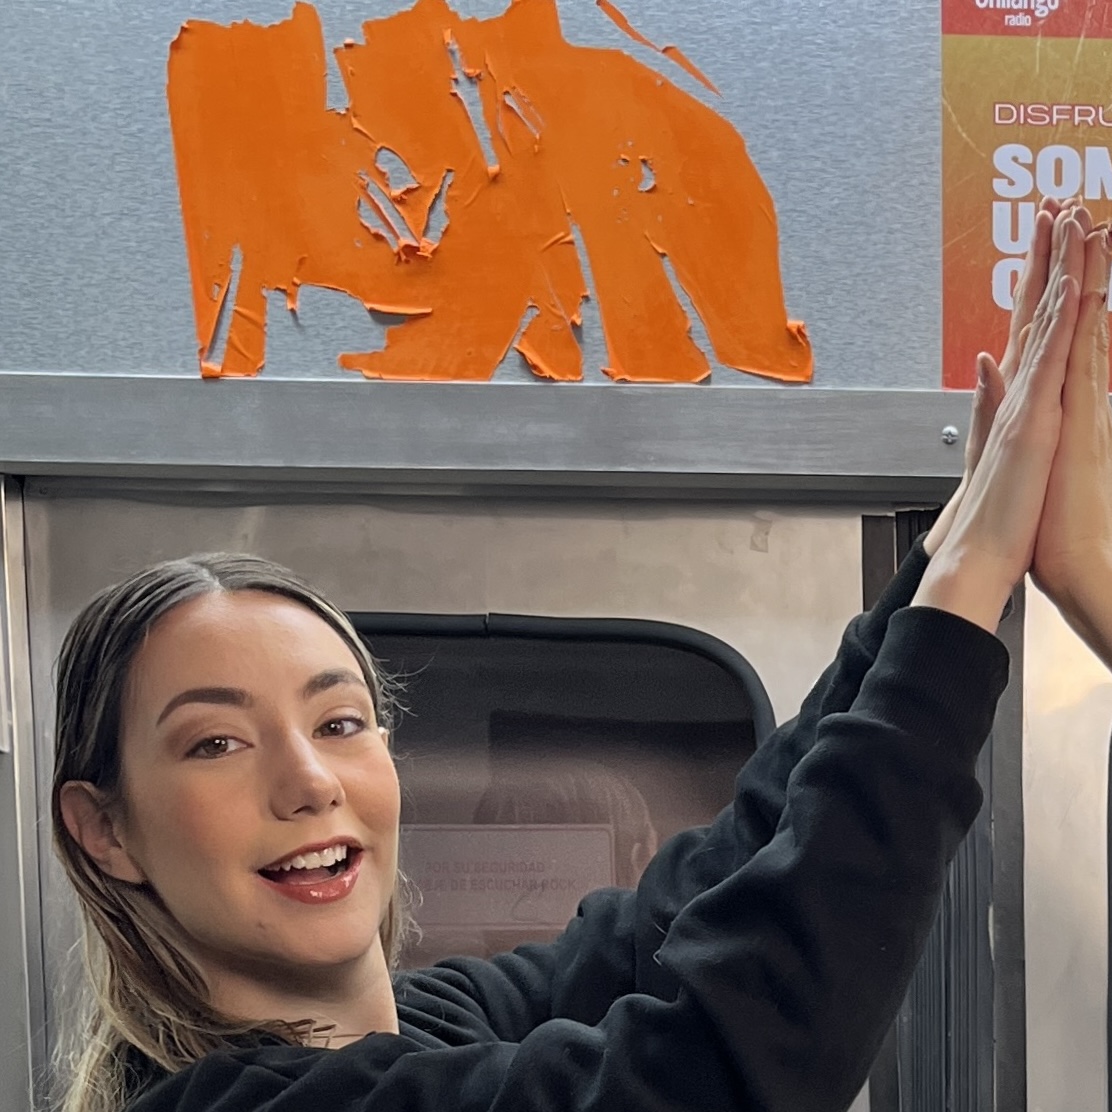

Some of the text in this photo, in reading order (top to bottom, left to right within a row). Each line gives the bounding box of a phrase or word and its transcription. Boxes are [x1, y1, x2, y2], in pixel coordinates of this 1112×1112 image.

[1004, 12, 1032, 26] radio
[992, 201, 1036, 254] U
[453, 861, 470, 874] SU
[474, 861, 546, 874] SEGURIDAD
[450, 878, 467, 892] DE
